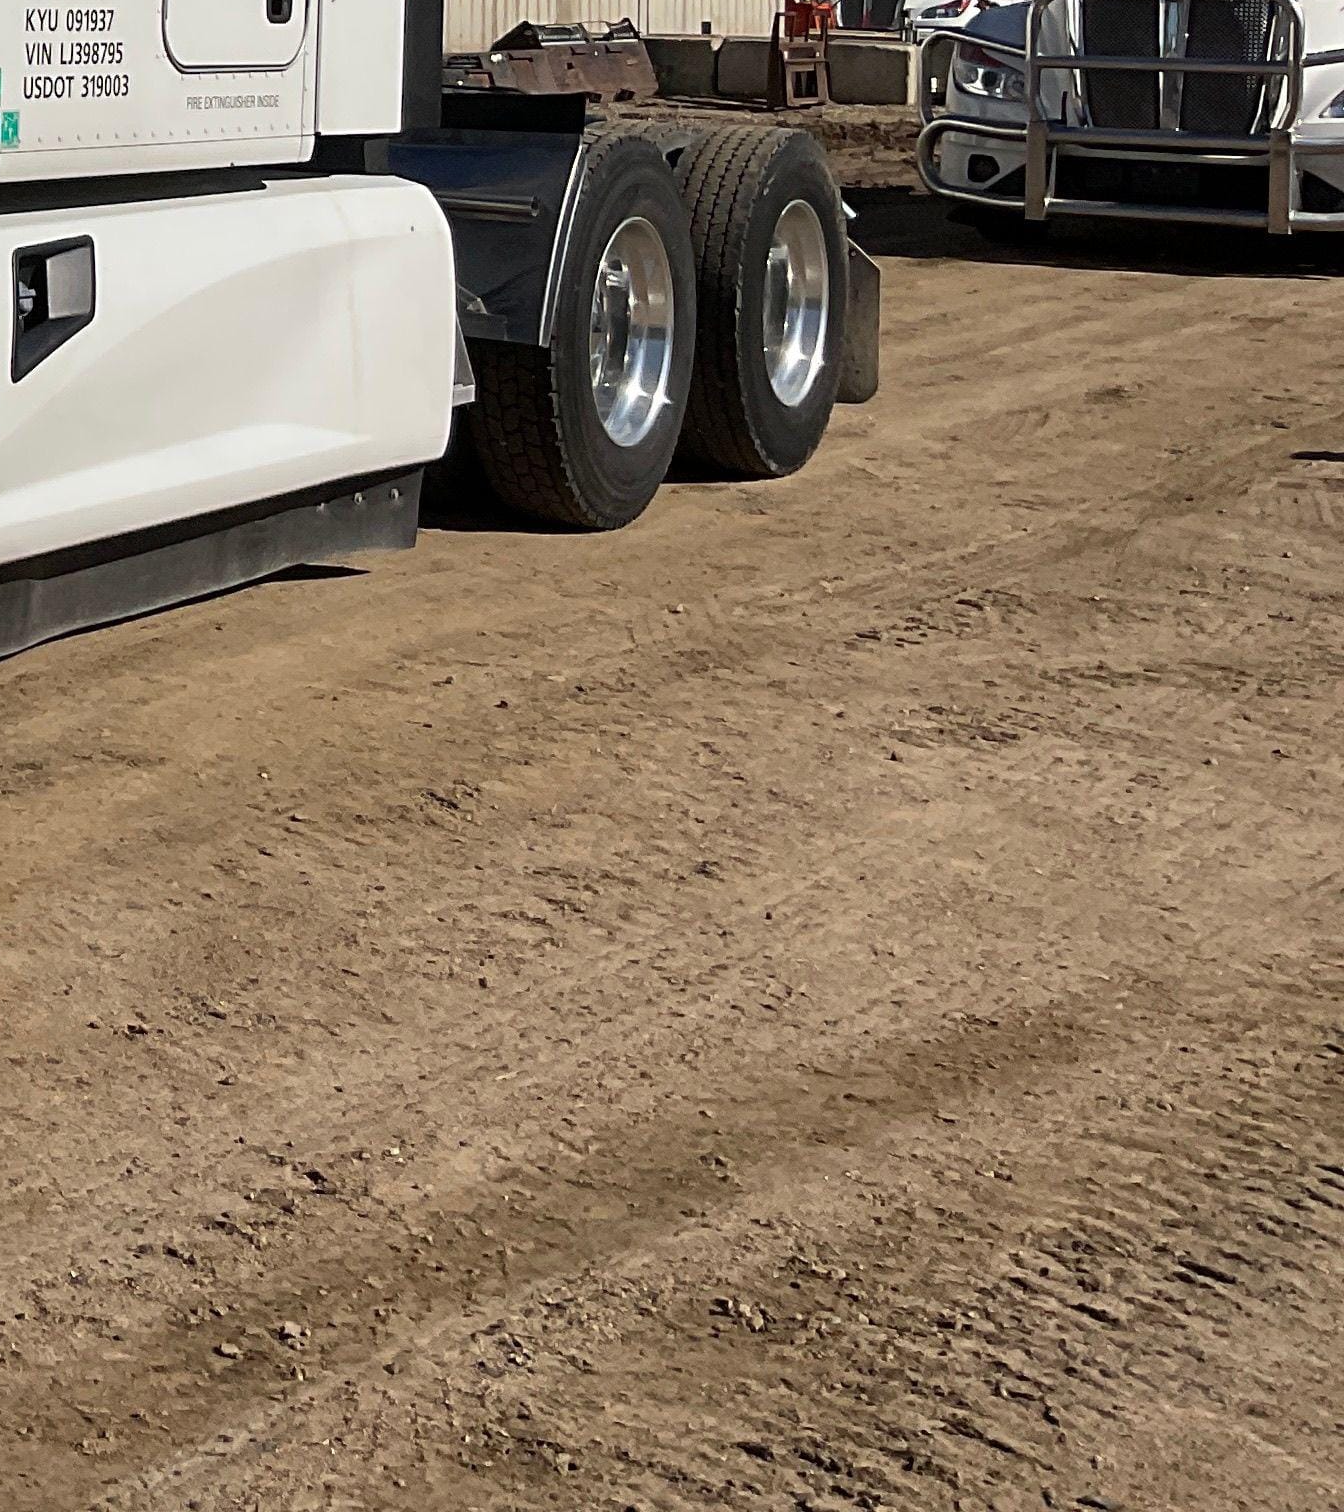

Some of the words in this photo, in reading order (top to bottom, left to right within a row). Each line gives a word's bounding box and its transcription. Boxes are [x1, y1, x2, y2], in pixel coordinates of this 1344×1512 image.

[25, 8, 58, 32] KYU
[66, 9, 114, 32] 091937
[25, 42, 52, 65] VIN
[60, 41, 123, 65] LJ398795
[23, 75, 75, 99] USDOT
[81, 74, 129, 98] 319003
